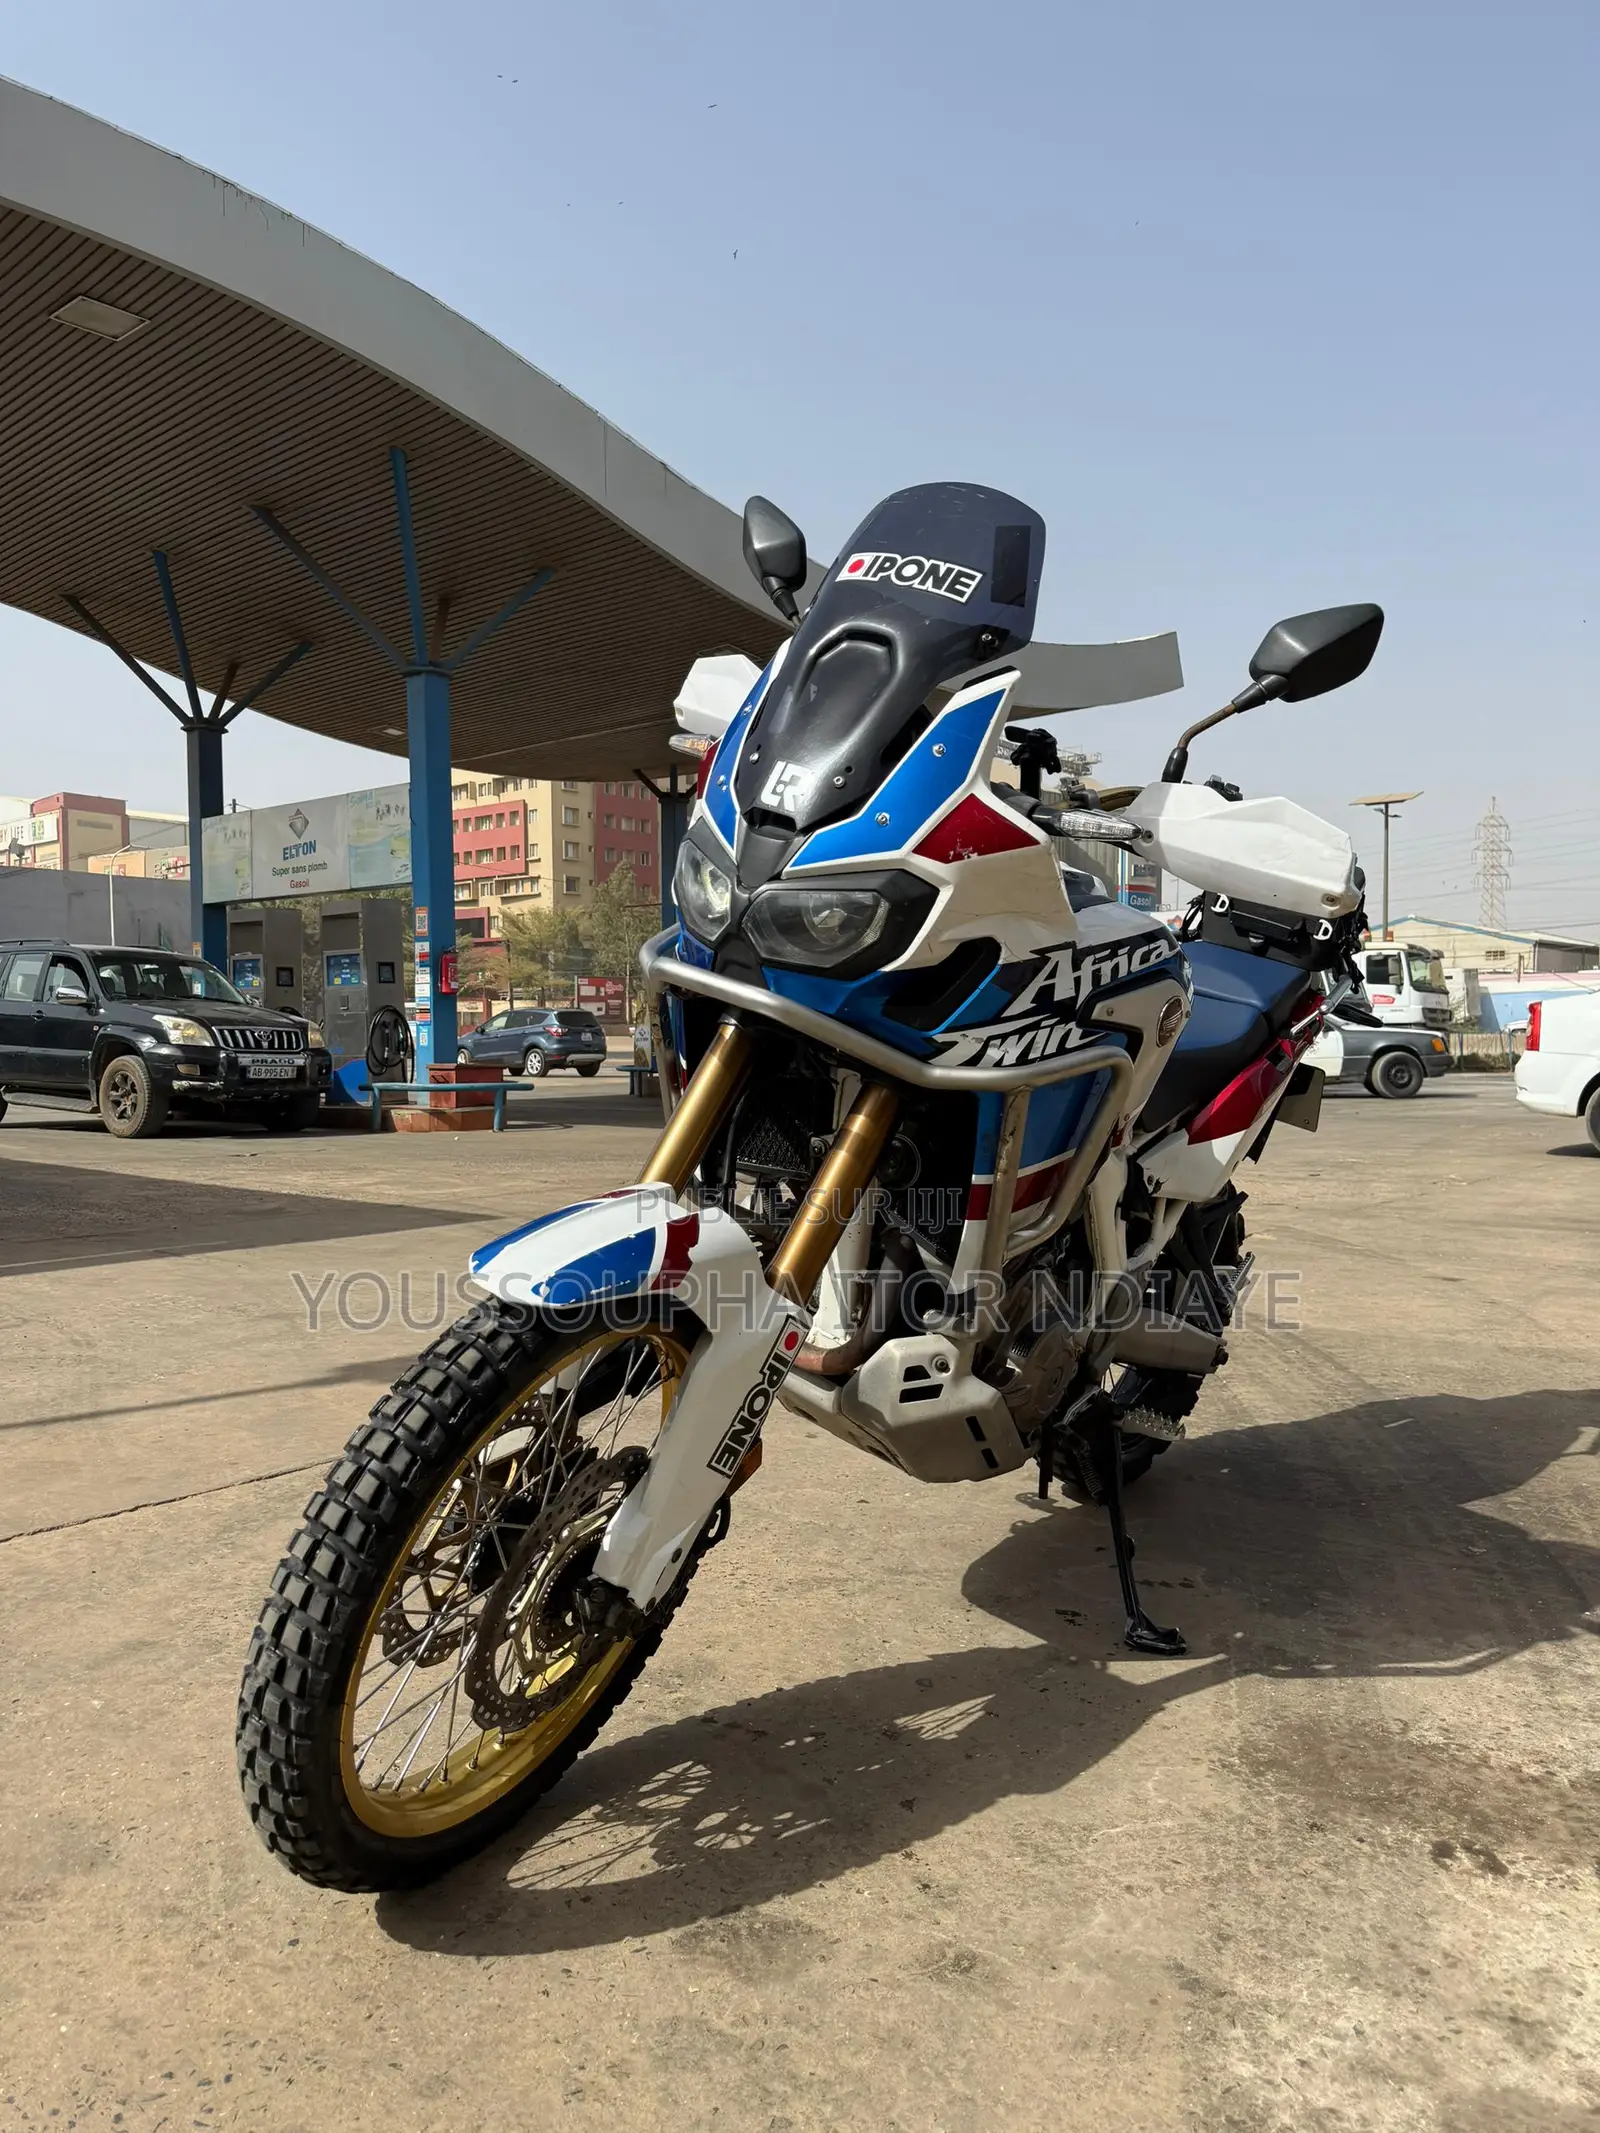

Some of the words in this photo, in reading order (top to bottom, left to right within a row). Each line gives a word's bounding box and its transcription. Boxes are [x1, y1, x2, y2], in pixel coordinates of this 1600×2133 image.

[862, 554, 978, 599] IPONE
[271, 866, 291, 878] Super
[291, 864, 307, 874] sans
[307, 861, 328, 874] plomb
[282, 839, 317, 861] ELTON
[1001, 939, 1181, 1017] Africa
[928, 1013, 1108, 1069] Twin
[714, 1350, 791, 1473] IPONE
